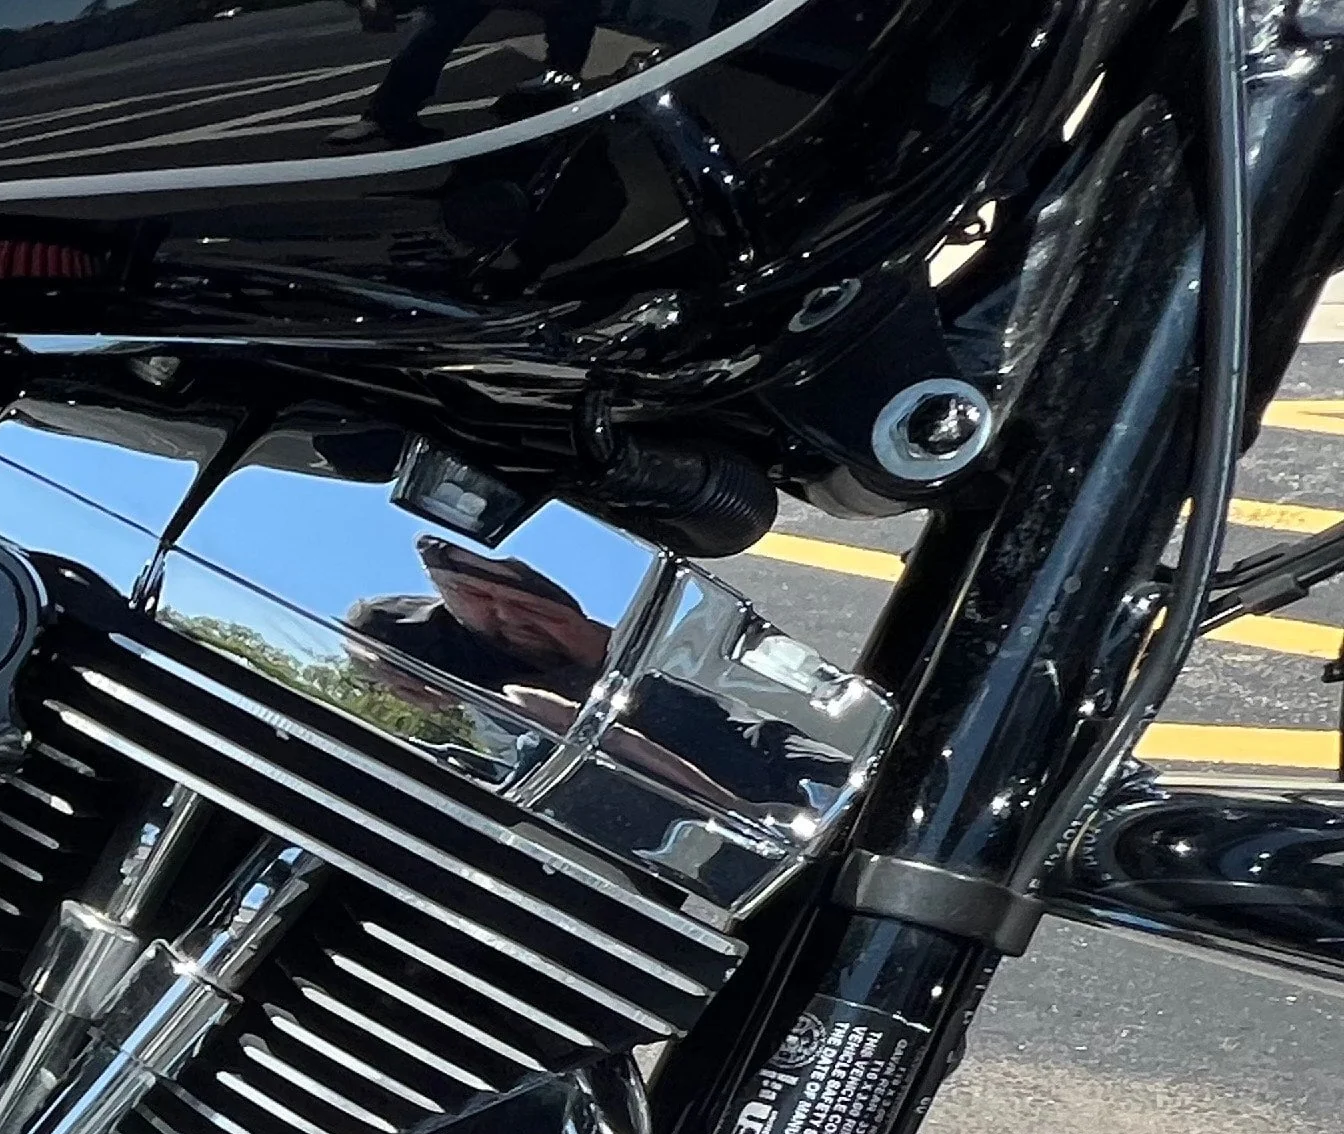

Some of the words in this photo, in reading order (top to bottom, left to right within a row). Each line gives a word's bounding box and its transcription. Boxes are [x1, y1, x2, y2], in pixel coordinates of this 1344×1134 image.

[826, 1022, 850, 1046] THE
[859, 1031, 883, 1058] THIS
[810, 1045, 837, 1081] DATE
[830, 1026, 867, 1079] VEHICLE
[803, 1081, 821, 1100] OF
[809, 1078, 841, 1127] SAFETY
[832, 1060, 868, 1113] VEHICLE
